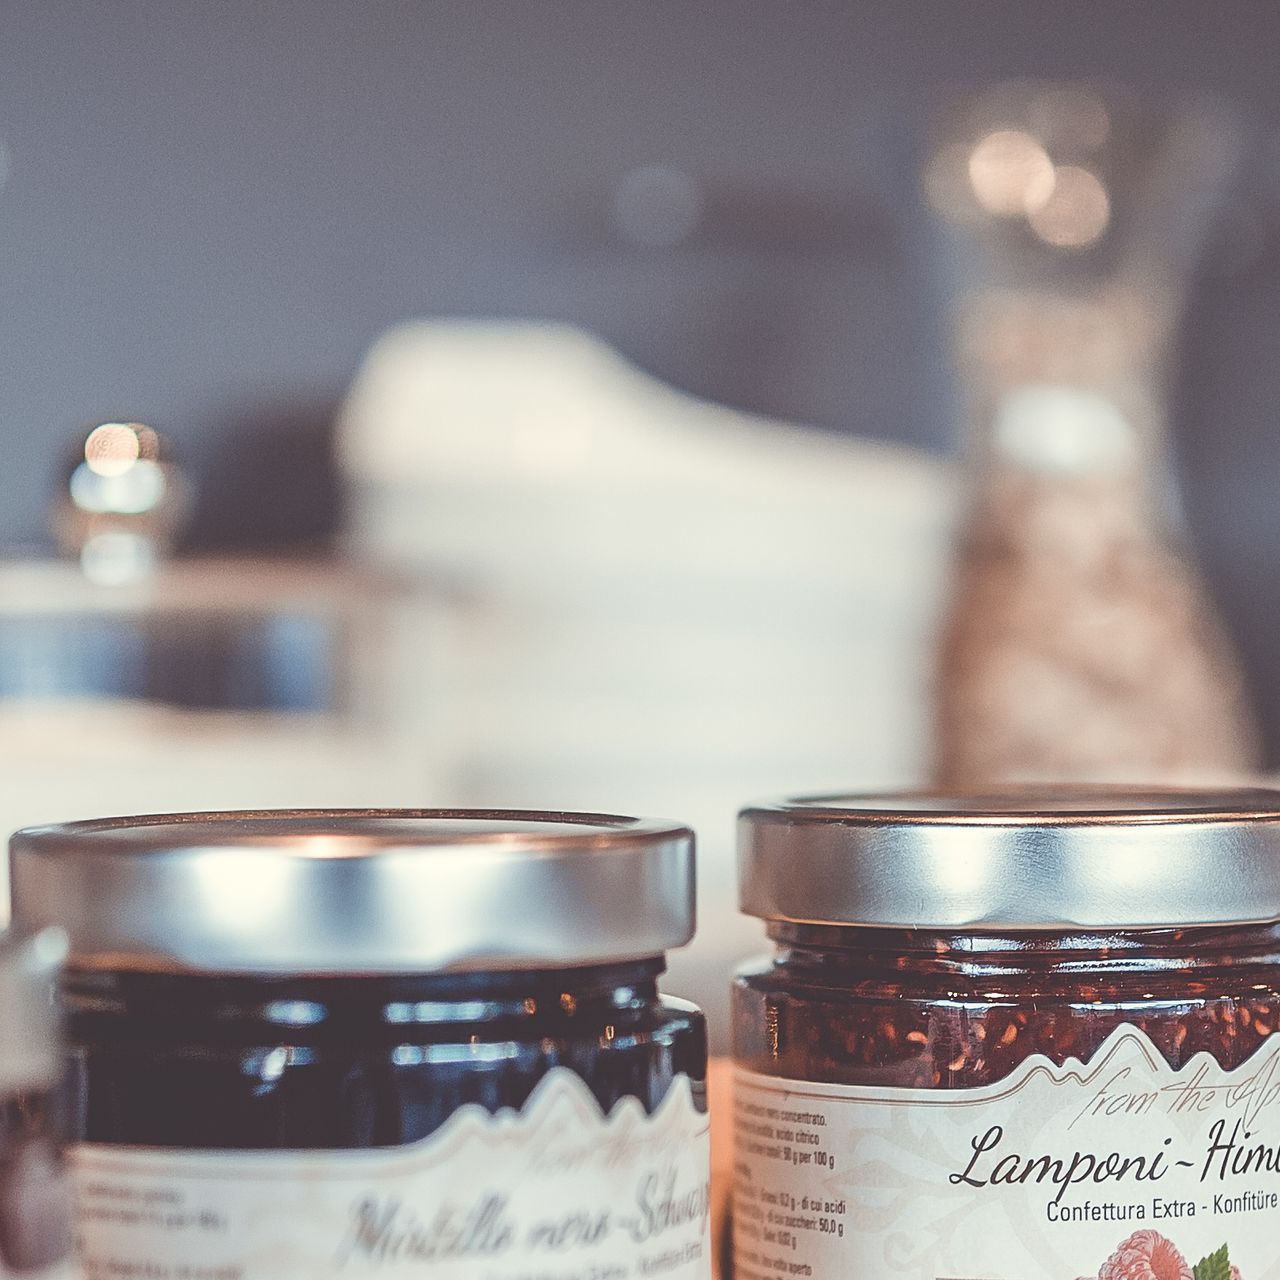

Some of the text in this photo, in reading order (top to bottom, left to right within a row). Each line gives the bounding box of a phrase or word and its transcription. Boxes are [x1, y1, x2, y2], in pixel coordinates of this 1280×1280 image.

[795, 1130, 820, 1146] citrico
[813, 1150, 827, 1167] 100
[829, 1155, 835, 1170] g
[948, 1124, 1172, 1203] Lamponi
[824, 1199, 847, 1215] acidi
[1046, 1200, 1145, 1223] Confettura
[1152, 1198, 1196, 1220] Extra
[1213, 1189, 1279, 1215] Konfitüre
[819, 1217, 837, 1235] 50,0
[838, 1223, 844, 1238] g
